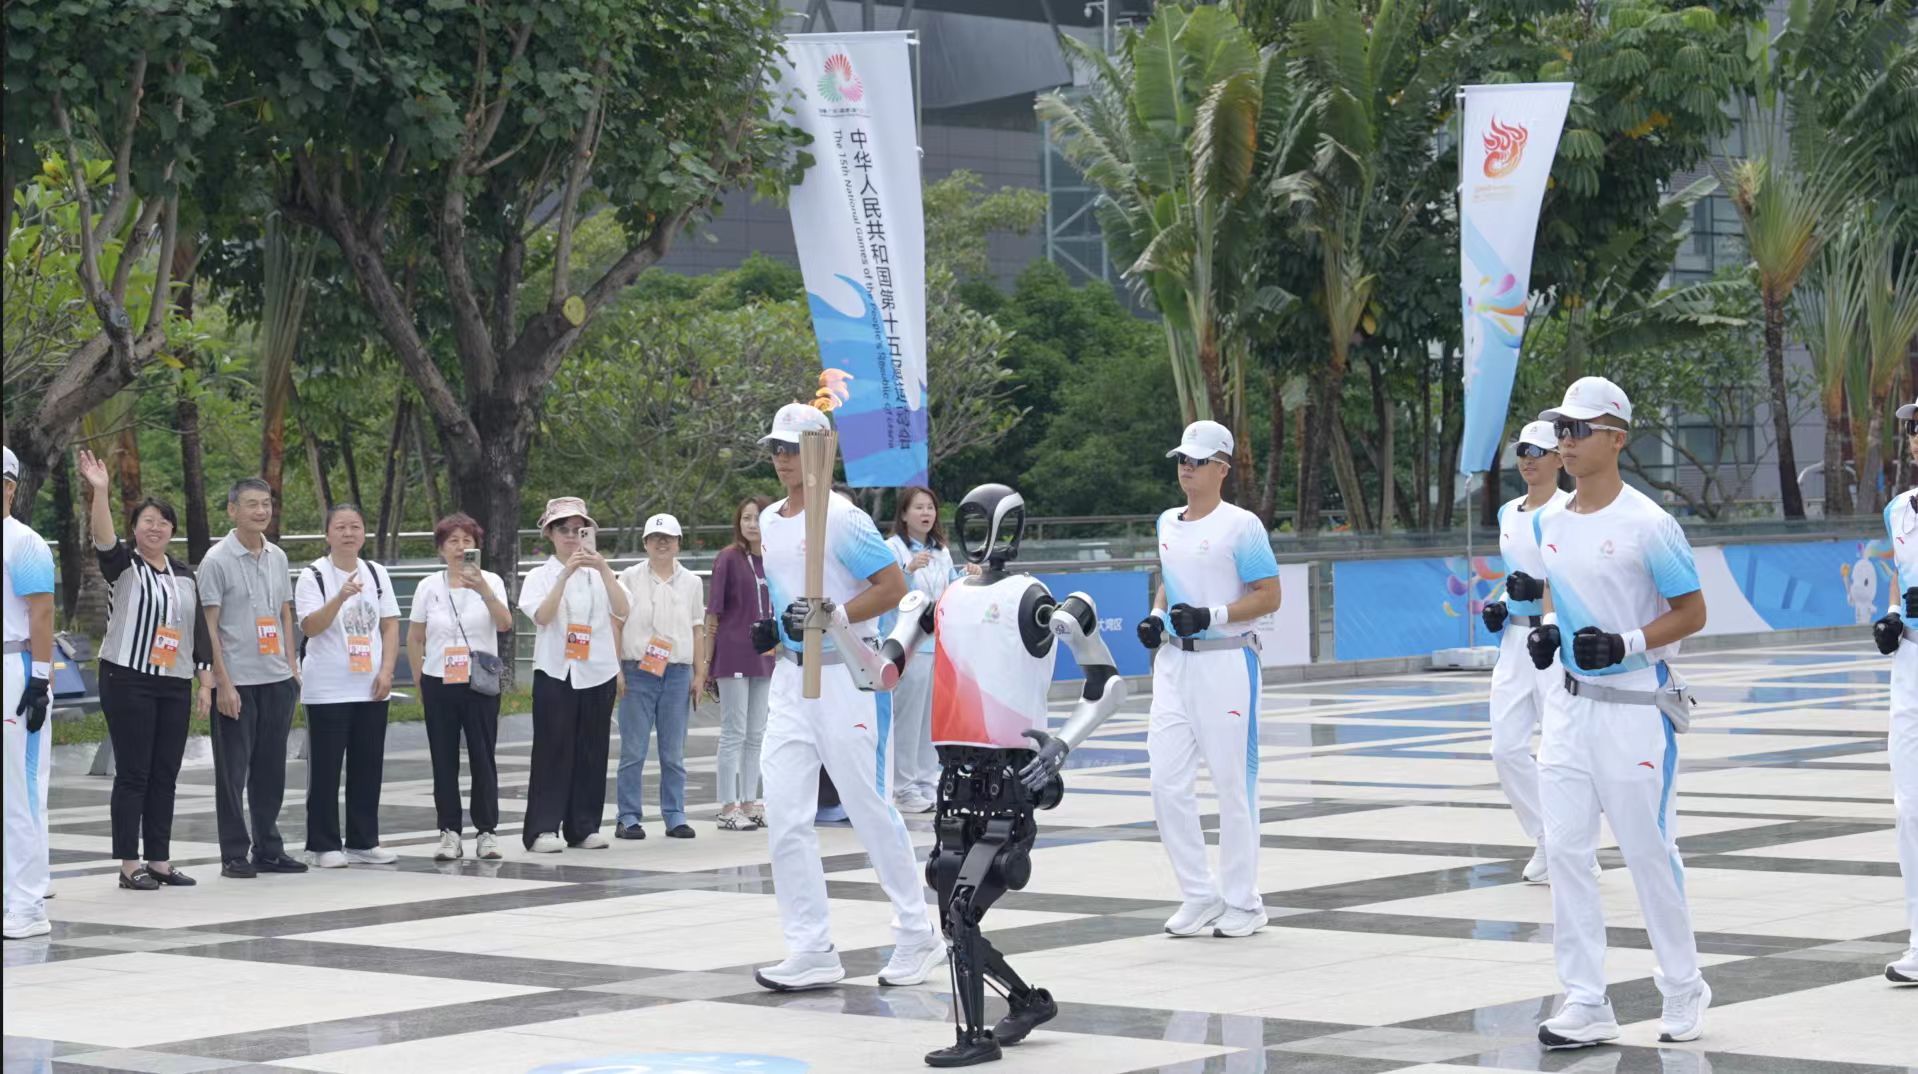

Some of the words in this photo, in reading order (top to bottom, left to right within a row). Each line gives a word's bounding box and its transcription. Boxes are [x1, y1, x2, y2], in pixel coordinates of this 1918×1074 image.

[833, 129, 843, 149] The
[838, 152, 850, 176] 15th
[844, 179, 861, 225] National
[856, 227, 869, 264] Games
[863, 268, 873, 279] of
